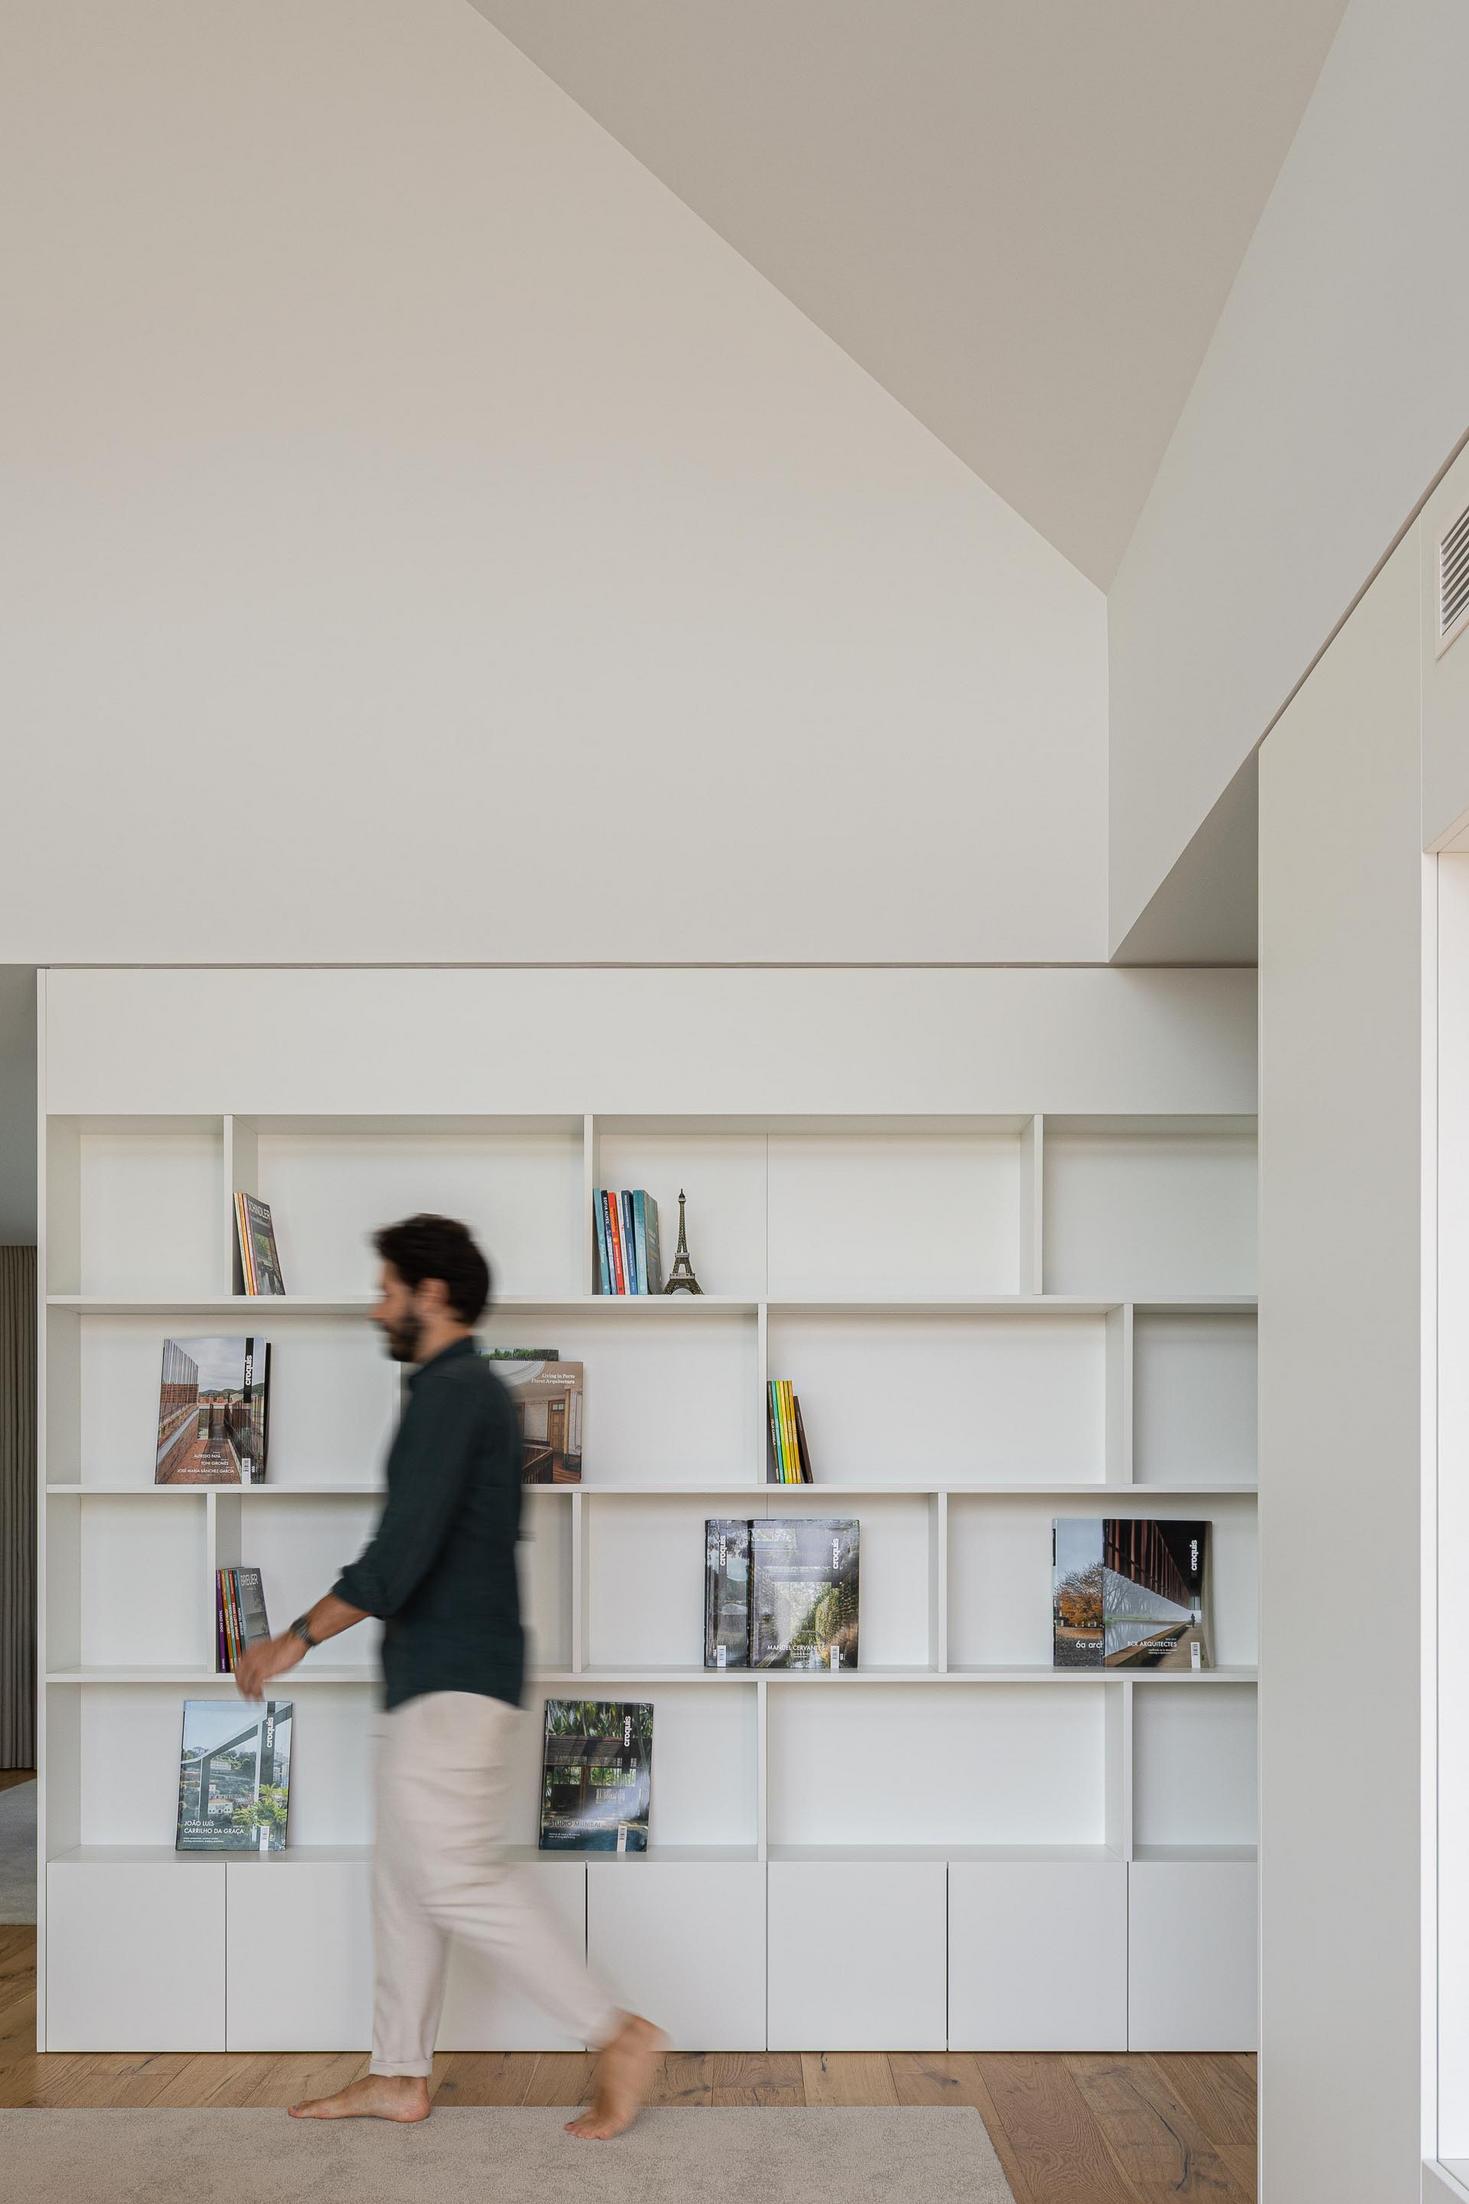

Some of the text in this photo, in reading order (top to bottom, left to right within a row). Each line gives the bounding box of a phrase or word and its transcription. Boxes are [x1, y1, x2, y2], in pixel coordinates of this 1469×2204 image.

[244, 1354, 254, 1386] croquis
[719, 1535, 728, 1566] croquis
[832, 1538, 840, 1570] croquis
[1190, 1539, 1199, 1571] croquis
[1075, 1640, 1086, 1649] 6a
[1139, 1640, 1178, 1648] ARQUITECTES
[266, 1716, 275, 1748] croquis
[624, 1715, 632, 1747] croquis
[184, 1819, 215, 1827] JOÃO LUÍS
[223, 1828, 245, 1836] GRAÇA
